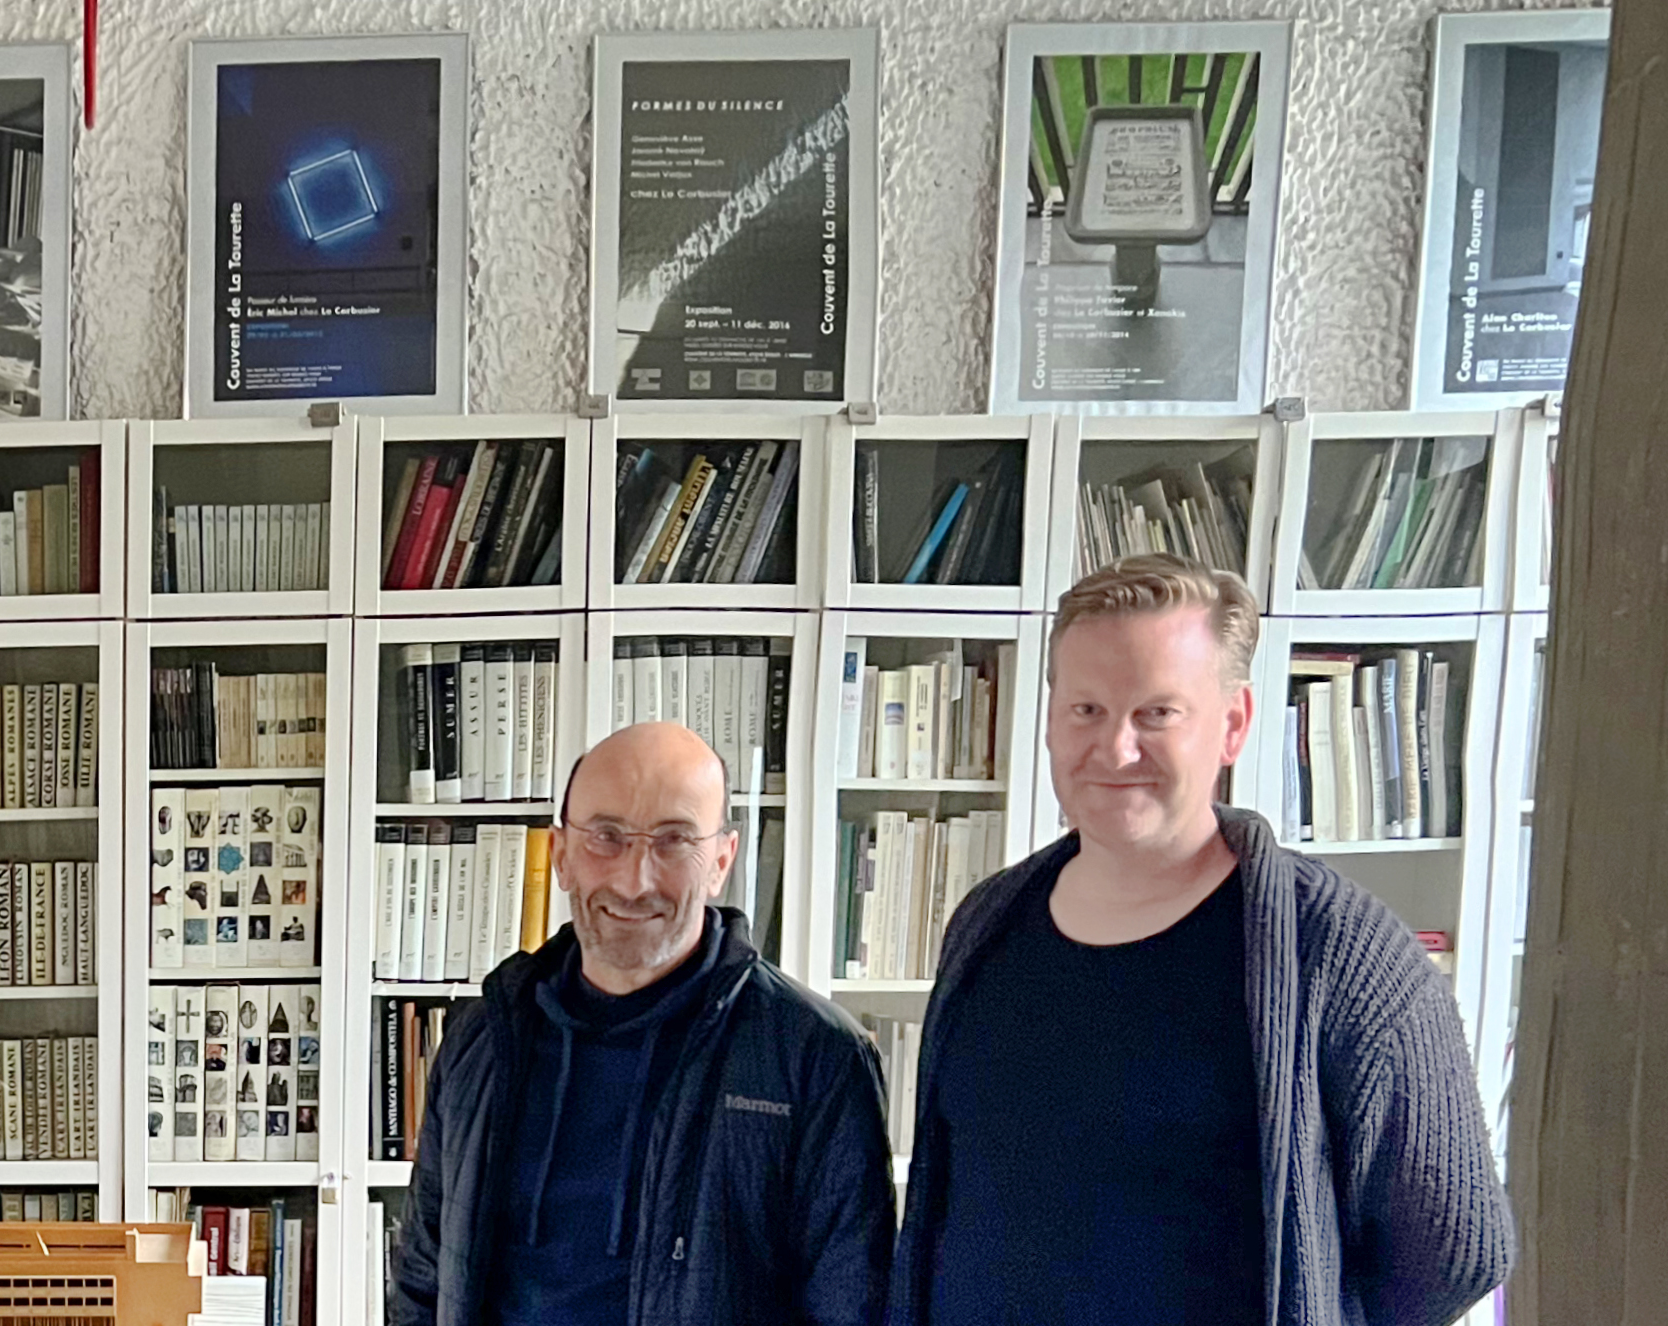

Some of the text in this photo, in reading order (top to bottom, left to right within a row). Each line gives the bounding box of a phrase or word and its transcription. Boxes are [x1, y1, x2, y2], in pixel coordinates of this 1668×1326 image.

[631, 99, 784, 112] FORMES DU SILENCE
[630, 189, 732, 199] chez Le Corbusier
[820, 152, 836, 335] Couvent de La Tourette
[226, 202, 242, 390] Couvent de La Tourette
[321, 306, 332, 316] Le
[334, 305, 381, 316] Corbusier
[685, 305, 733, 317] Exposition
[1032, 199, 1053, 390] Couvent de La Tourette
[1456, 188, 1485, 382] Couvent de La Tourette
[684, 319, 696, 329] 20
[731, 319, 742, 329] 11
[767, 320, 791, 330] 2016
[1502, 322, 1573, 333] Le Corbusier
[61, 688, 72, 751] ROMANE
[81, 689, 96, 750] ROMANE
[446, 676, 455, 739] SUMER
[470, 675, 479, 737] ASSUR
[497, 674, 507, 736] PERSE
[518, 674, 529, 752] LES HITTITES
[1382, 677, 1395, 714] MARIE
[6, 689, 16, 804] ALPES ROMANES
[26, 689, 37, 807] ALSACE ROMANE
[43, 688, 54, 806] CORSE ROMANE
[535, 744, 544, 764] LES
[60, 867, 69, 909] ROMAN
[35, 868, 46, 979] ILE-DE-FRANCE
[7, 1047, 17, 1097] ROMANE
[37, 1043, 48, 1100] ROMANE
[56, 1044, 65, 1113] IRLANDAIS
[73, 1044, 82, 1112] IRLANDAIS
[86, 1043, 96, 1111] IRLANDAIS
